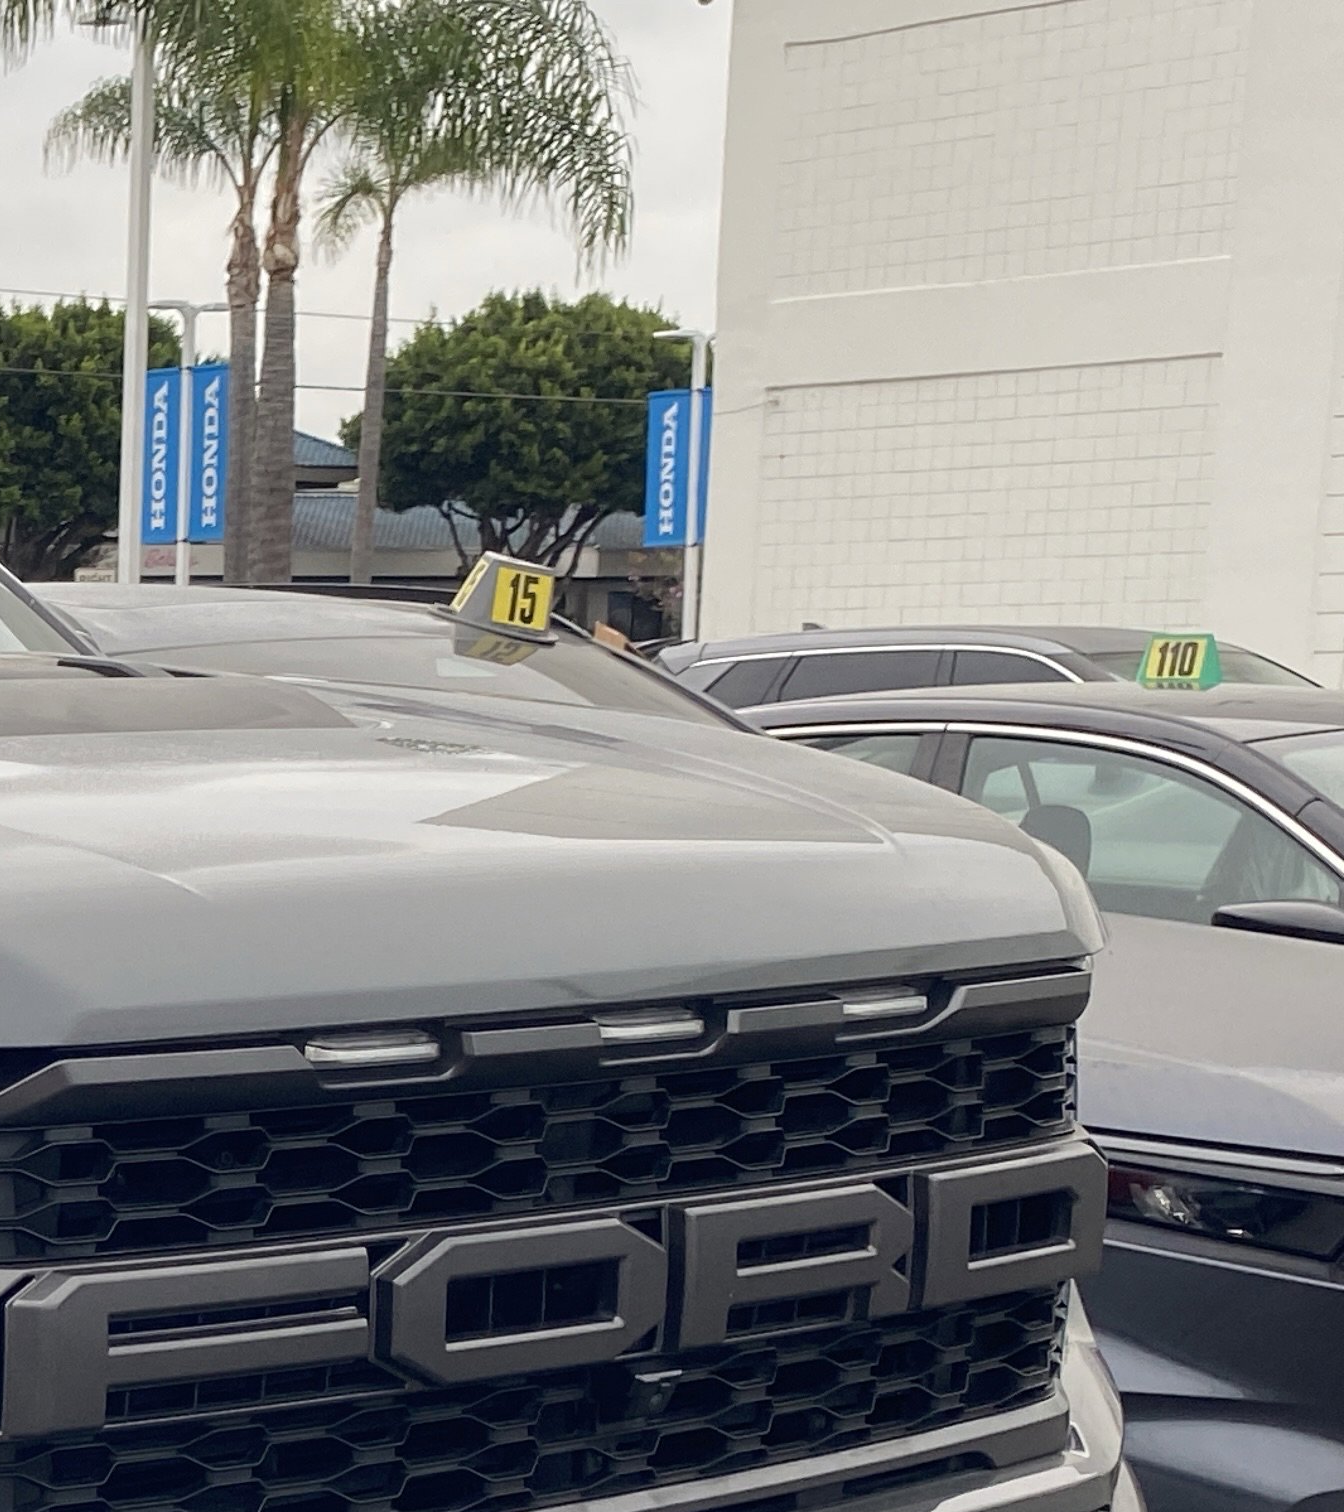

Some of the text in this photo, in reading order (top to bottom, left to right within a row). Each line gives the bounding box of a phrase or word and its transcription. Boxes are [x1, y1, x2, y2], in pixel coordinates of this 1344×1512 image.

[150, 380, 169, 531] HONDA
[201, 376, 220, 528] HONDA
[658, 401, 679, 536] HONDA
[508, 573, 540, 625] 15
[1156, 641, 1200, 678] 110
[1, 1139, 1106, 1442] FORD
